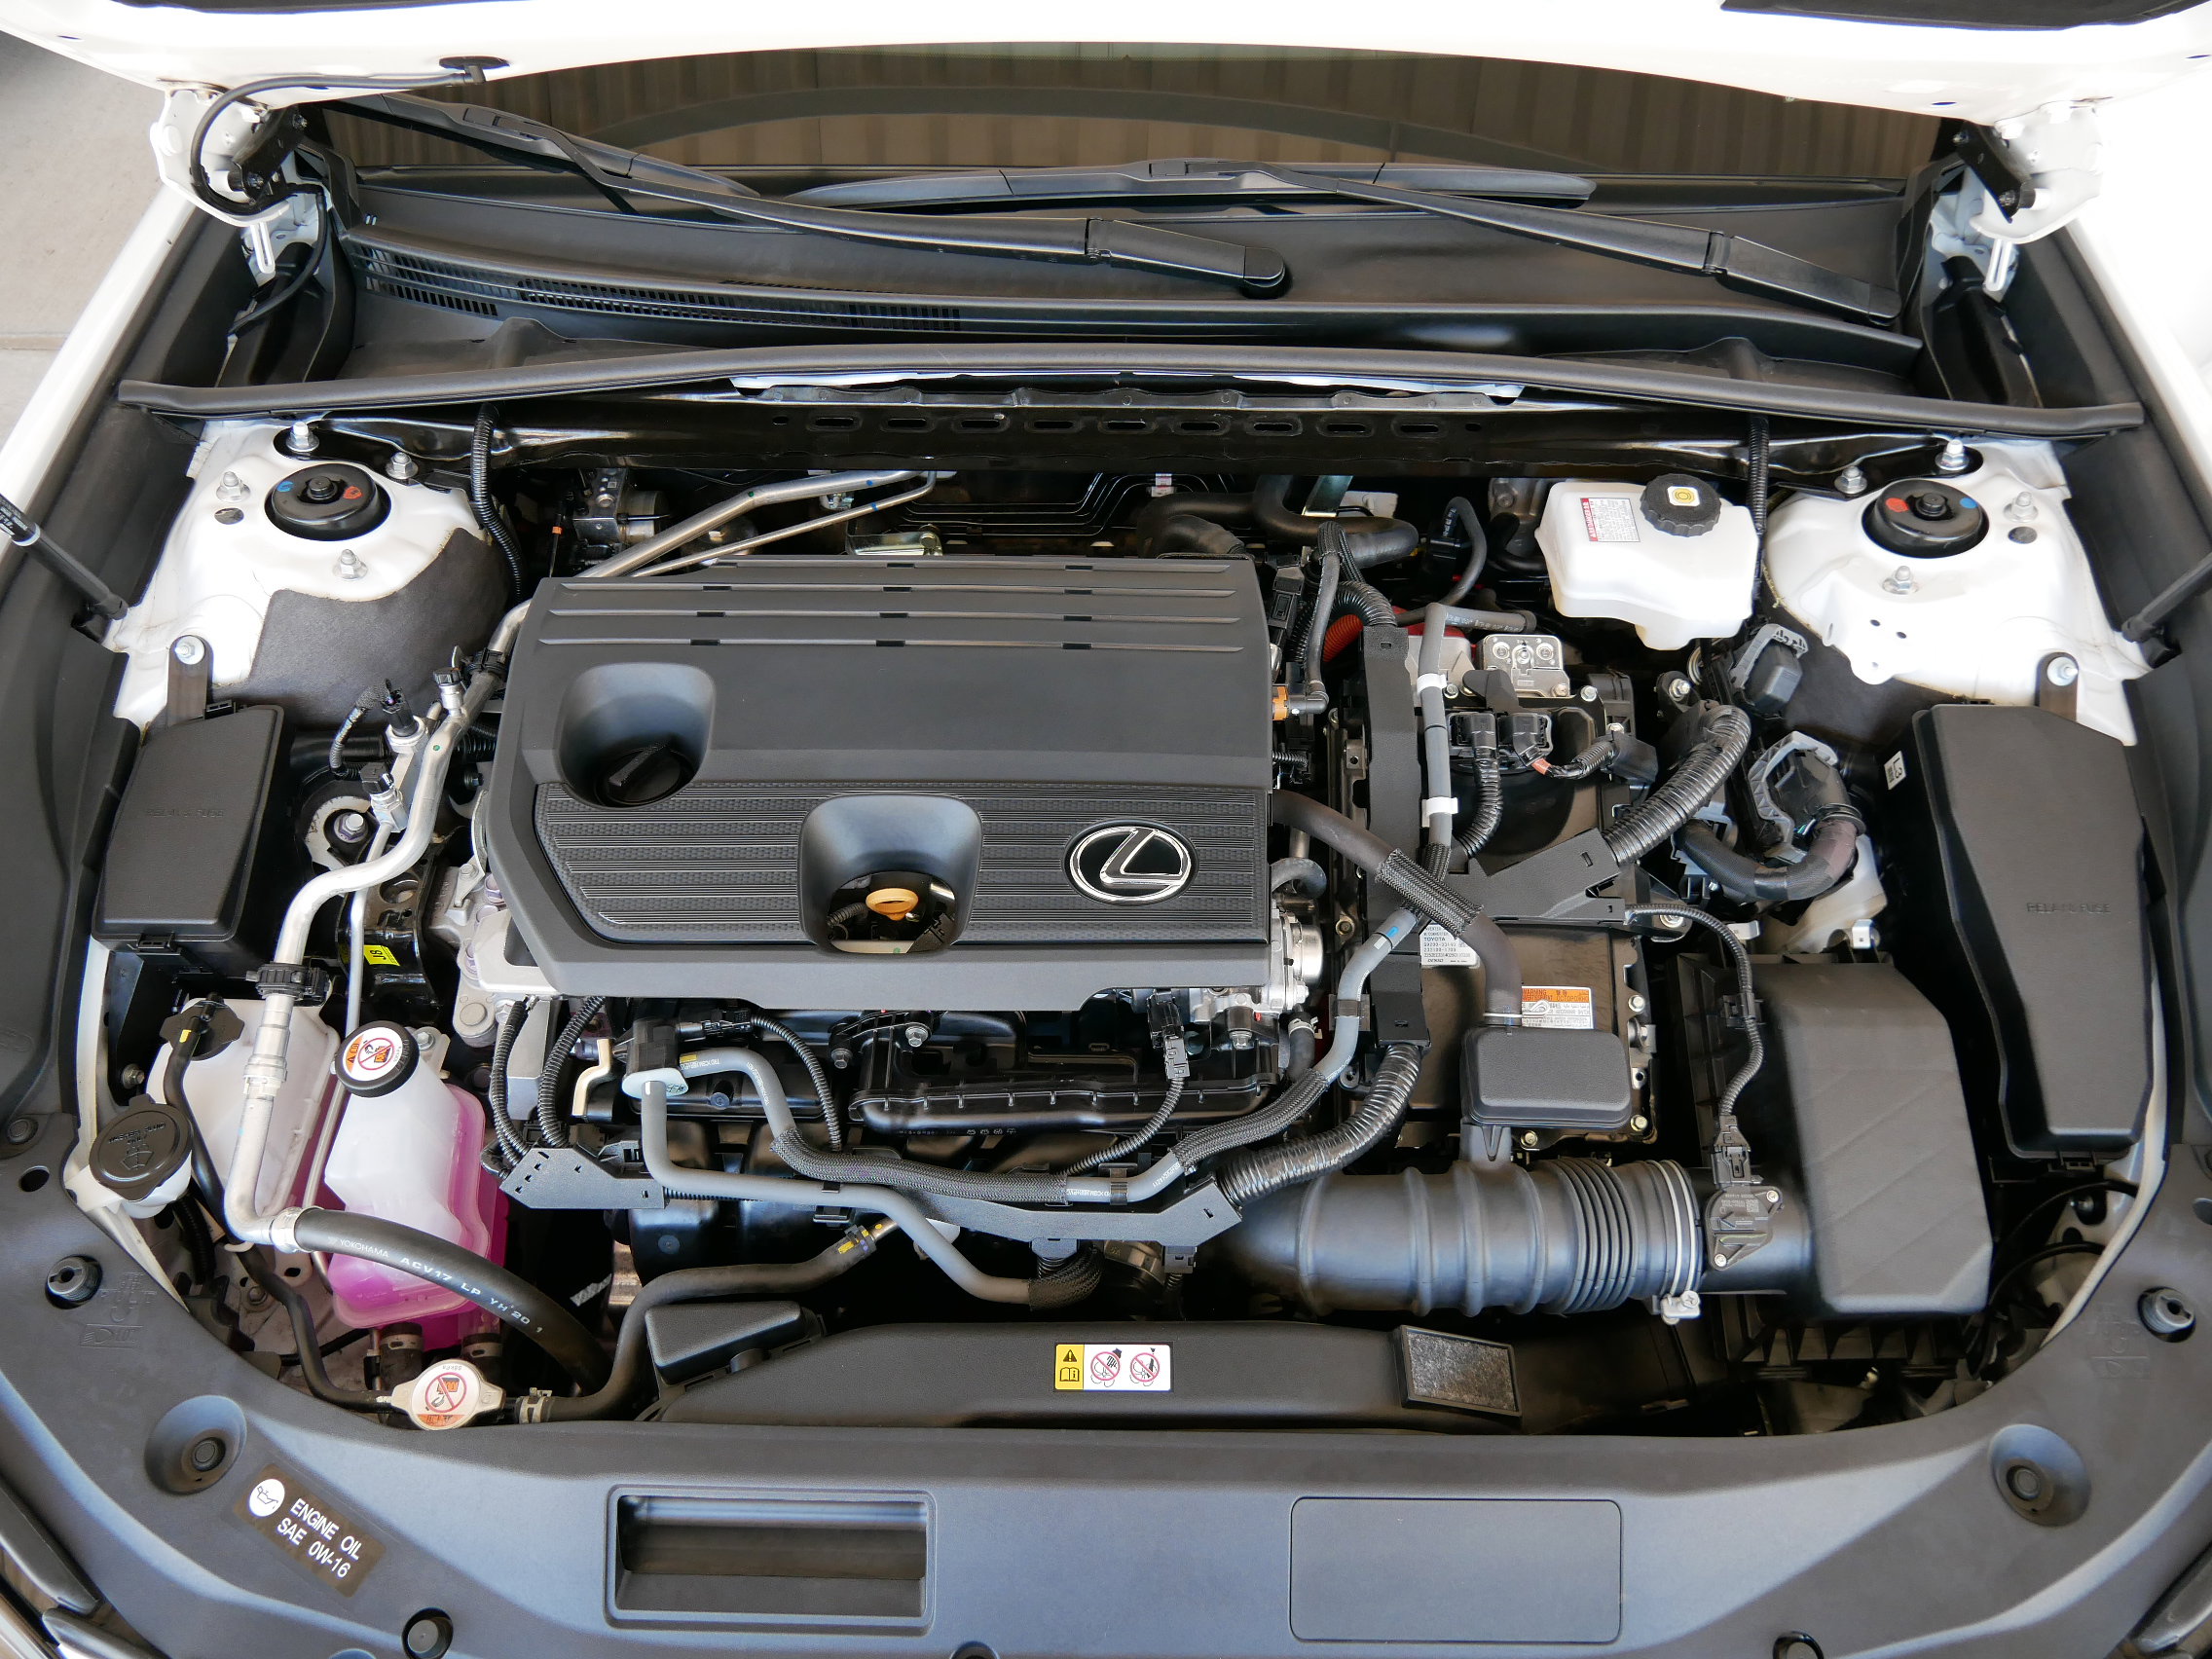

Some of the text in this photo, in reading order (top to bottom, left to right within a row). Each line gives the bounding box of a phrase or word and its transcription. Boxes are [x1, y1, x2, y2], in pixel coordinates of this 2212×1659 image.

[1893, 757, 1902, 778] L3
[341, 1238, 389, 1258] YOKOHAMA
[400, 1257, 453, 1281] ACV17
[461, 1282, 482, 1296] LP
[276, 1518, 351, 1578] SAE 0W-16
[290, 1497, 362, 1561] ENGINE OIL
